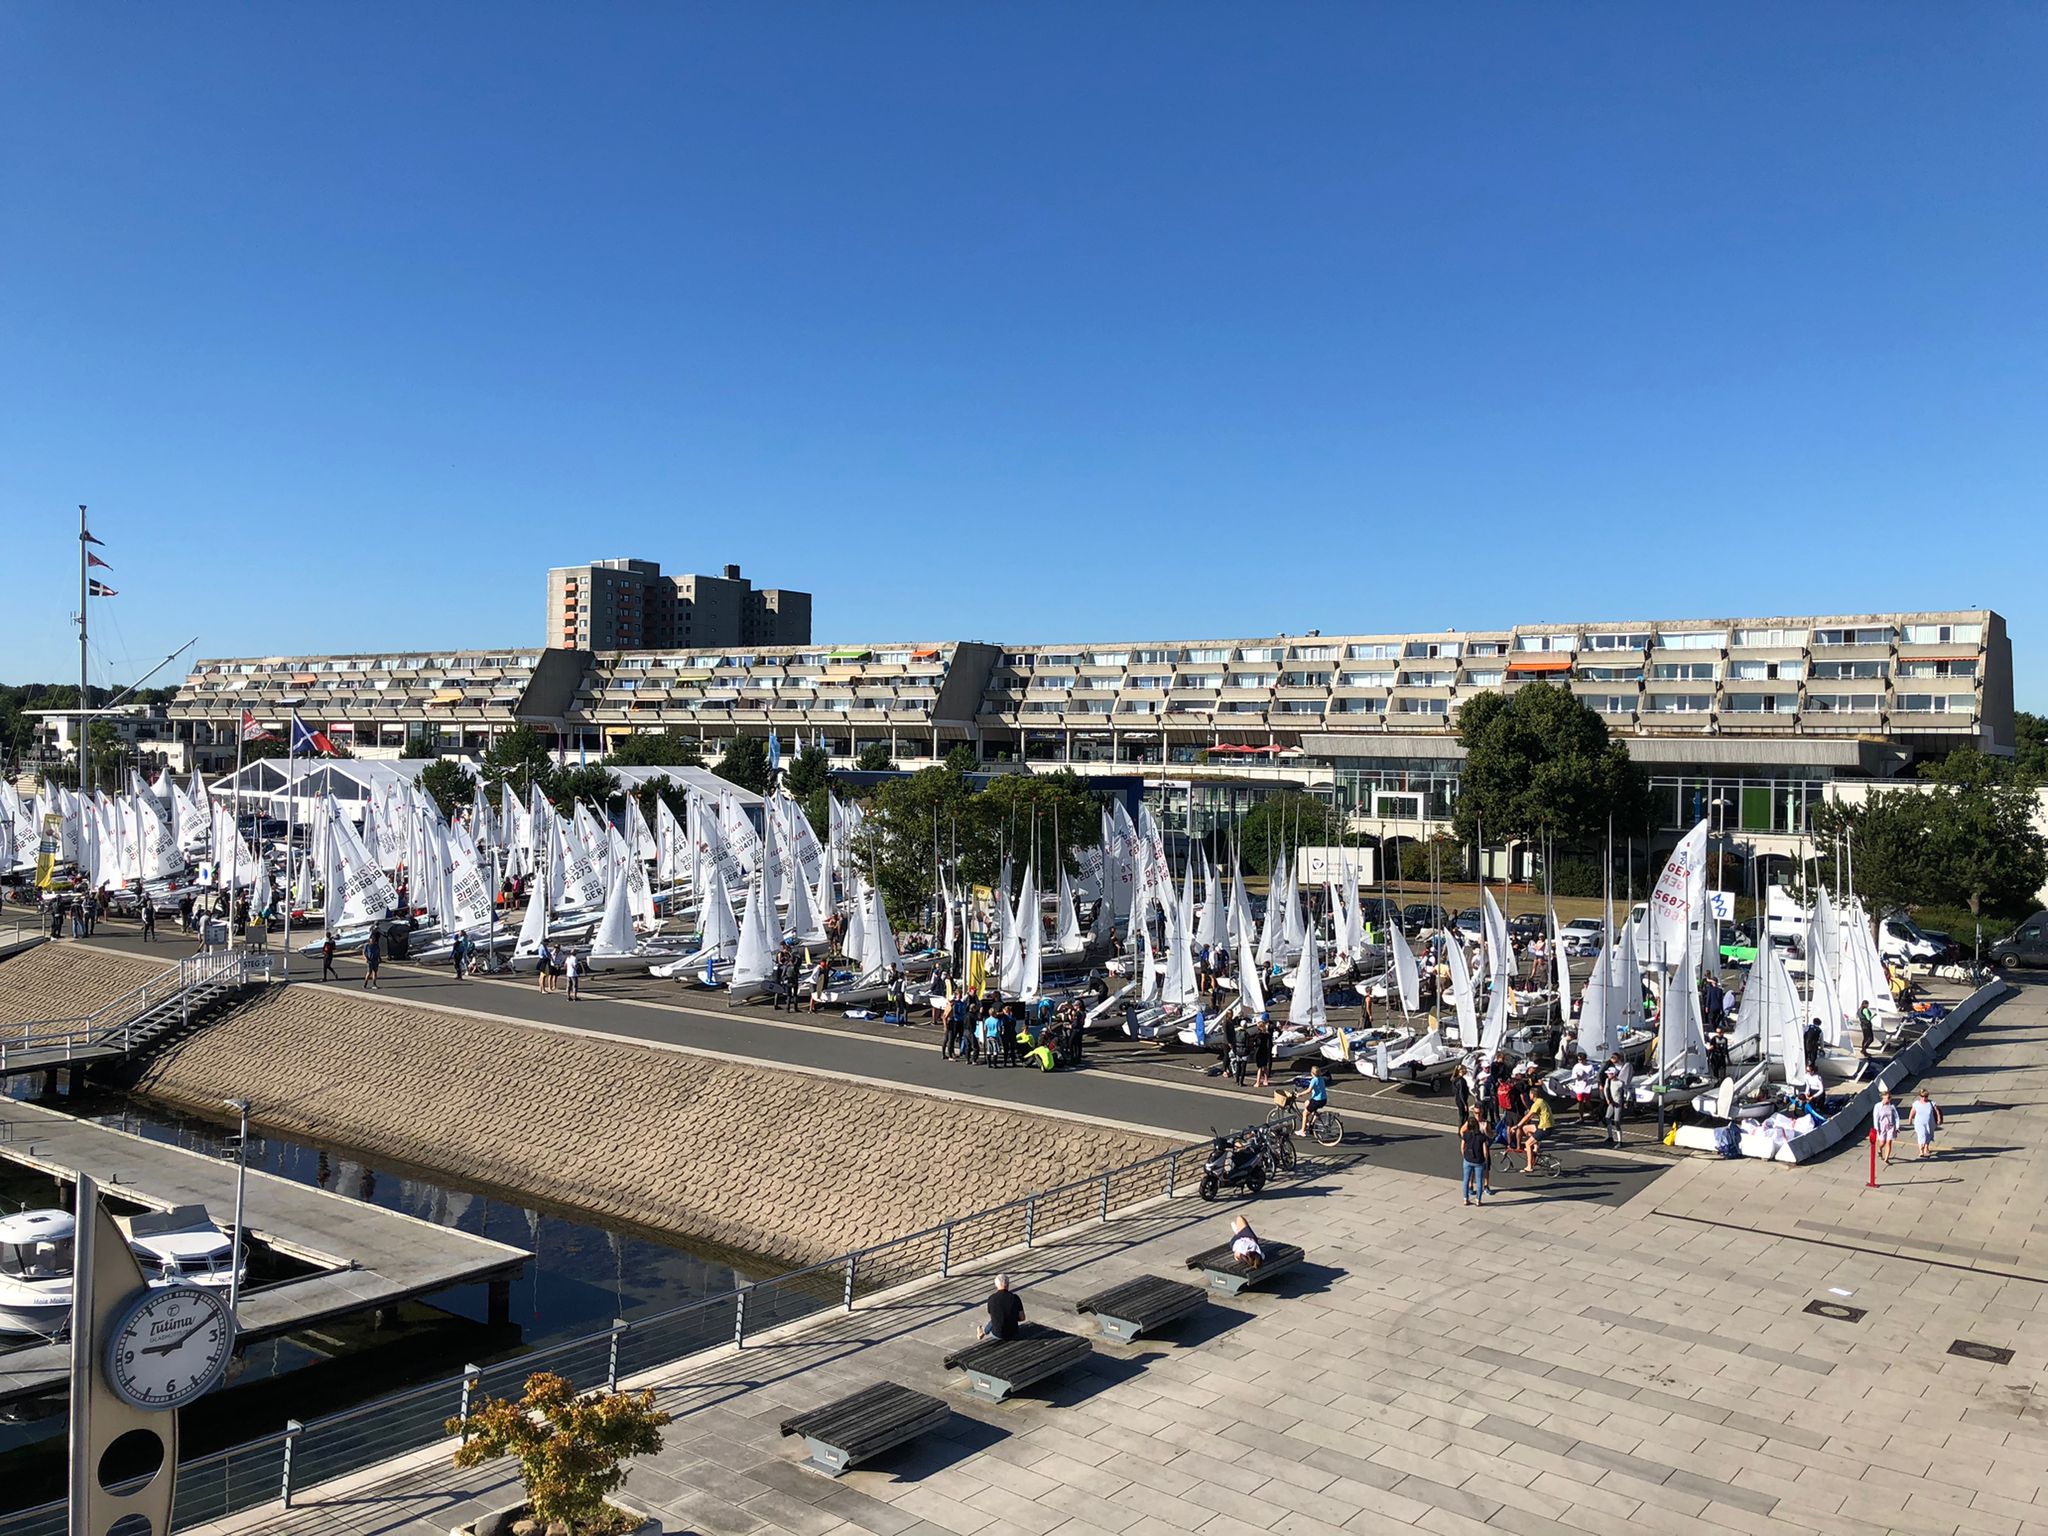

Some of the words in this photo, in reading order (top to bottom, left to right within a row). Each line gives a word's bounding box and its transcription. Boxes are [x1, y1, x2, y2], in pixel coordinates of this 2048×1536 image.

[14, 833, 37, 852] 212751
[558, 846, 572, 861] ILCA
[169, 856, 184, 869] GER
[335, 857, 349, 873] ILCA
[443, 860, 460, 877] ILCA
[1667, 862, 1690, 877] GER
[564, 865, 592, 889] 213273
[383, 892, 397, 904] ER
[585, 888, 603, 901] GER
[365, 901, 385, 915] GER
[474, 904, 491, 919] GER
[1711, 893, 1728, 917] 420
[243, 960, 260, 968] STEG
[261, 958, 273, 966] 5-6
[150, 1316, 195, 1337] Tutima
[208, 1329, 218, 1342] 3
[124, 1351, 134, 1364] 9
[166, 1379, 176, 1393] 6
